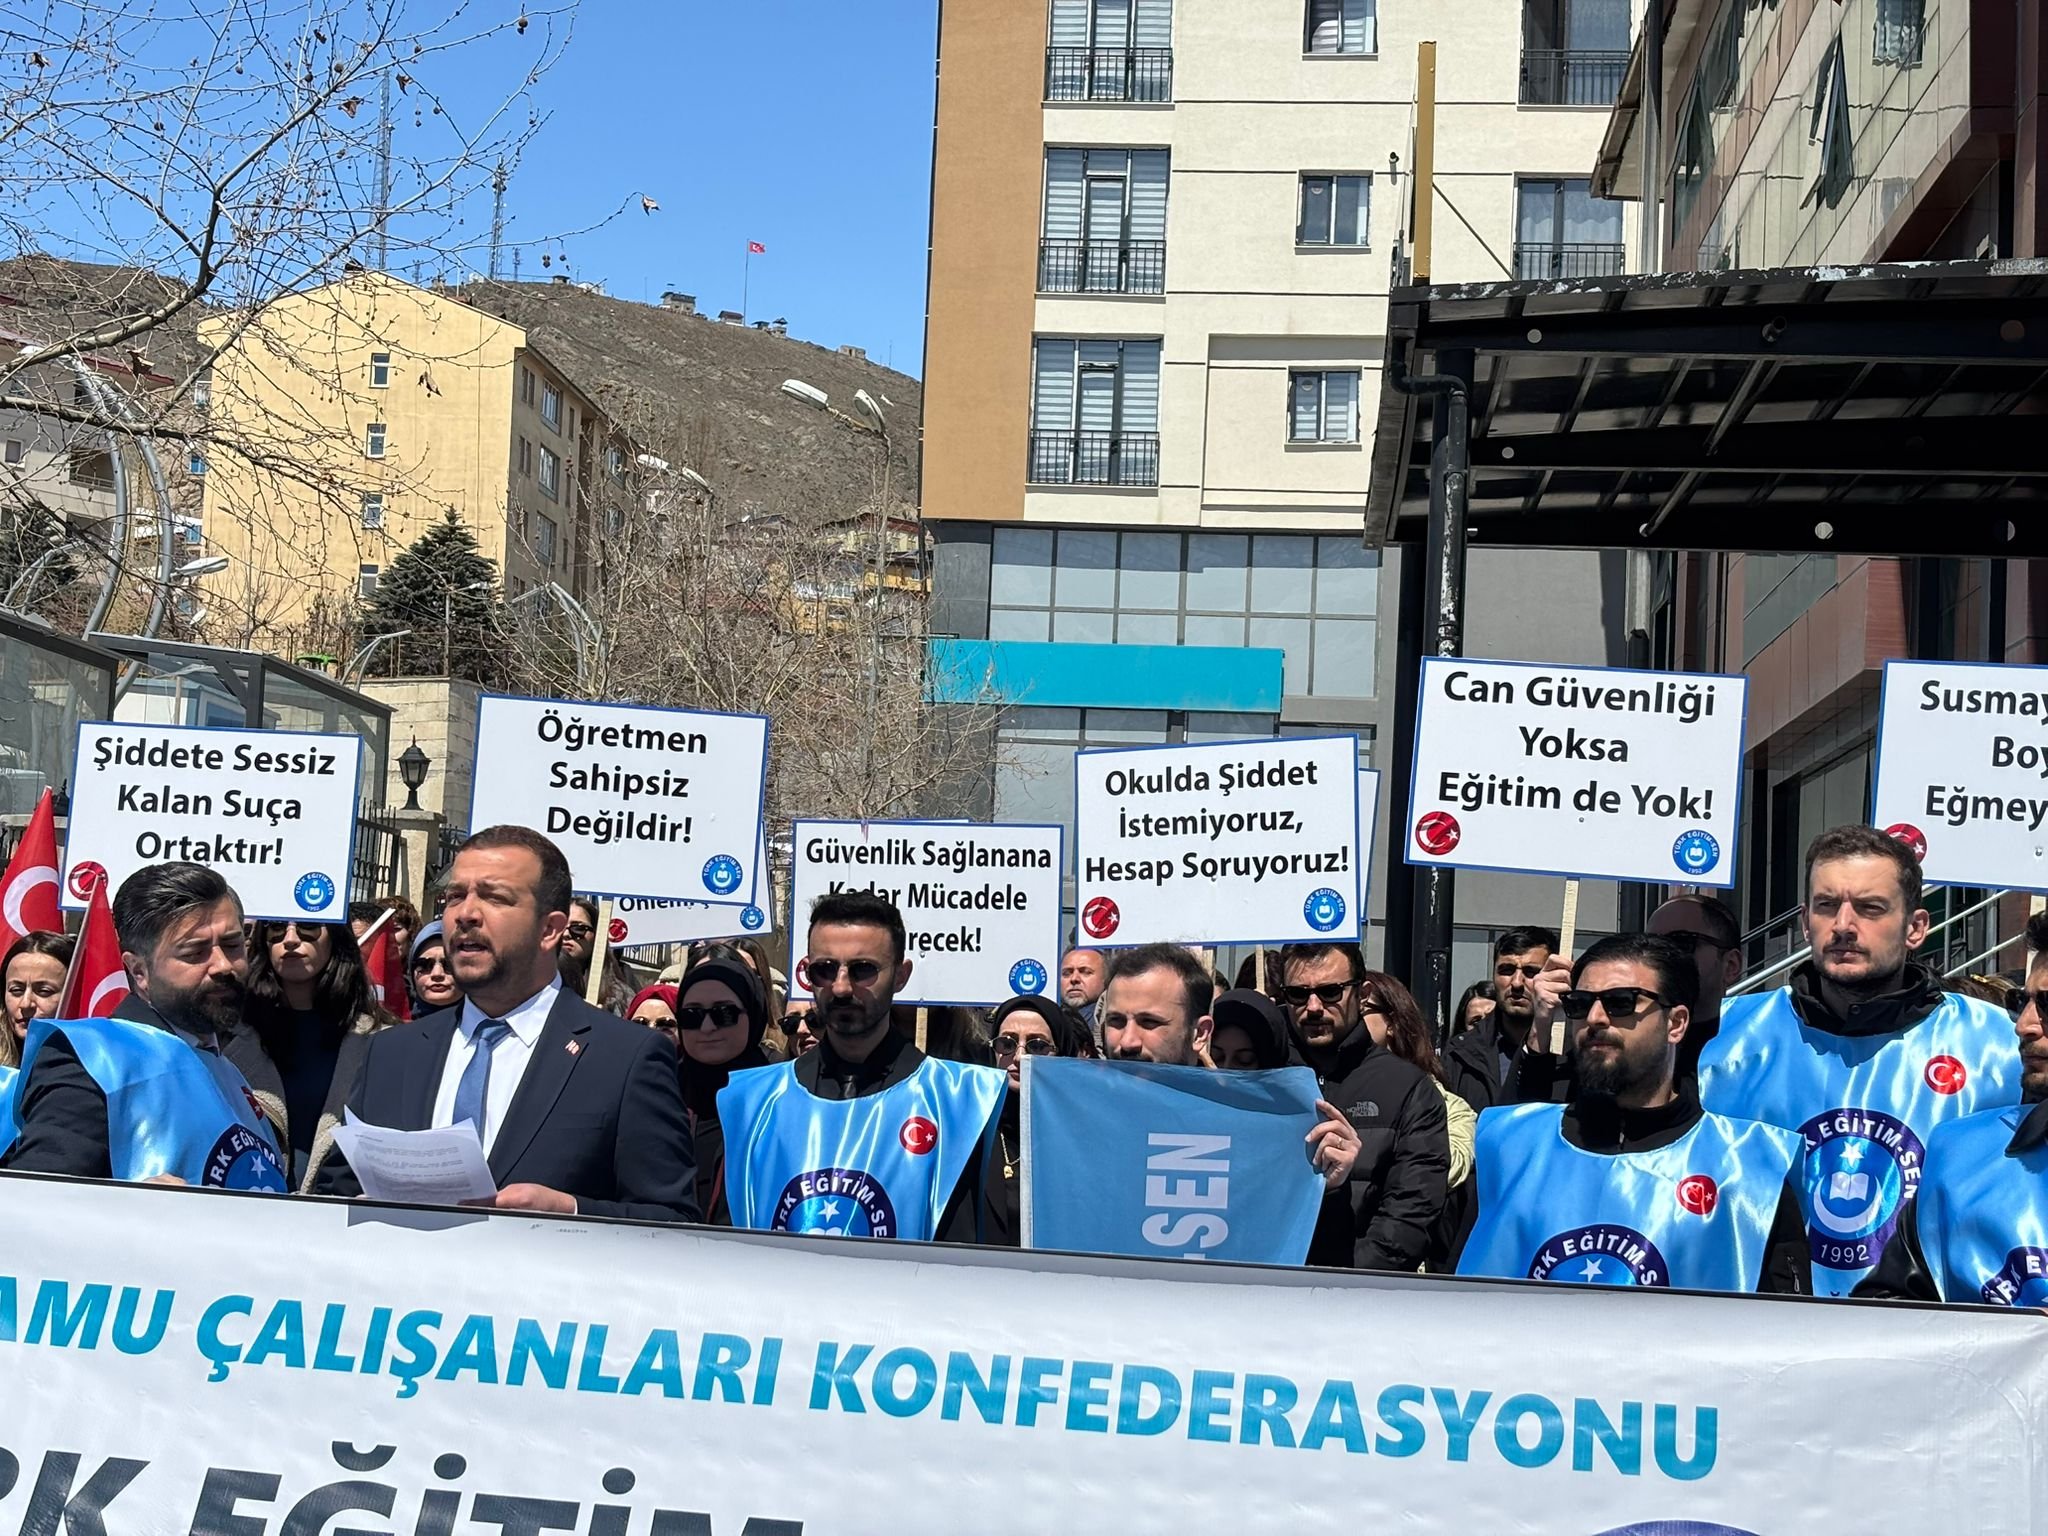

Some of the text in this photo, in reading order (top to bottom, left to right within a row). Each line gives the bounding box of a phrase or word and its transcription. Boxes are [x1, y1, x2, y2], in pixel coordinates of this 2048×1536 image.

[1445, 670, 1716, 724] Can Güvenliği
[538, 709, 708, 754] Öğretmen
[1519, 726, 1629, 763] Yoksa
[93, 736, 336, 775] Şiddete Sessiz
[549, 761, 689, 800] Sahipsiz
[1105, 759, 1318, 797] Okulda Şiddet
[1438, 771, 1713, 820] Eğitim de Yok!
[117, 784, 302, 826] Kalan Suça
[1119, 804, 1303, 841] İstemiyoruz,
[546, 806, 693, 846] Değildir!
[135, 830, 283, 865] Ortaktır!
[805, 838, 1052, 872] Güvenlik Sağlanana
[1085, 845, 1349, 887] Hesap Soruyoruz!
[907, 882, 1027, 911] Mücadele
[1820, 1243, 1870, 1264] 1992
[197, 1295, 782, 1400] ÇALIŞANLARI
[809, 1343, 1717, 1480] KONFEDERASYONU
